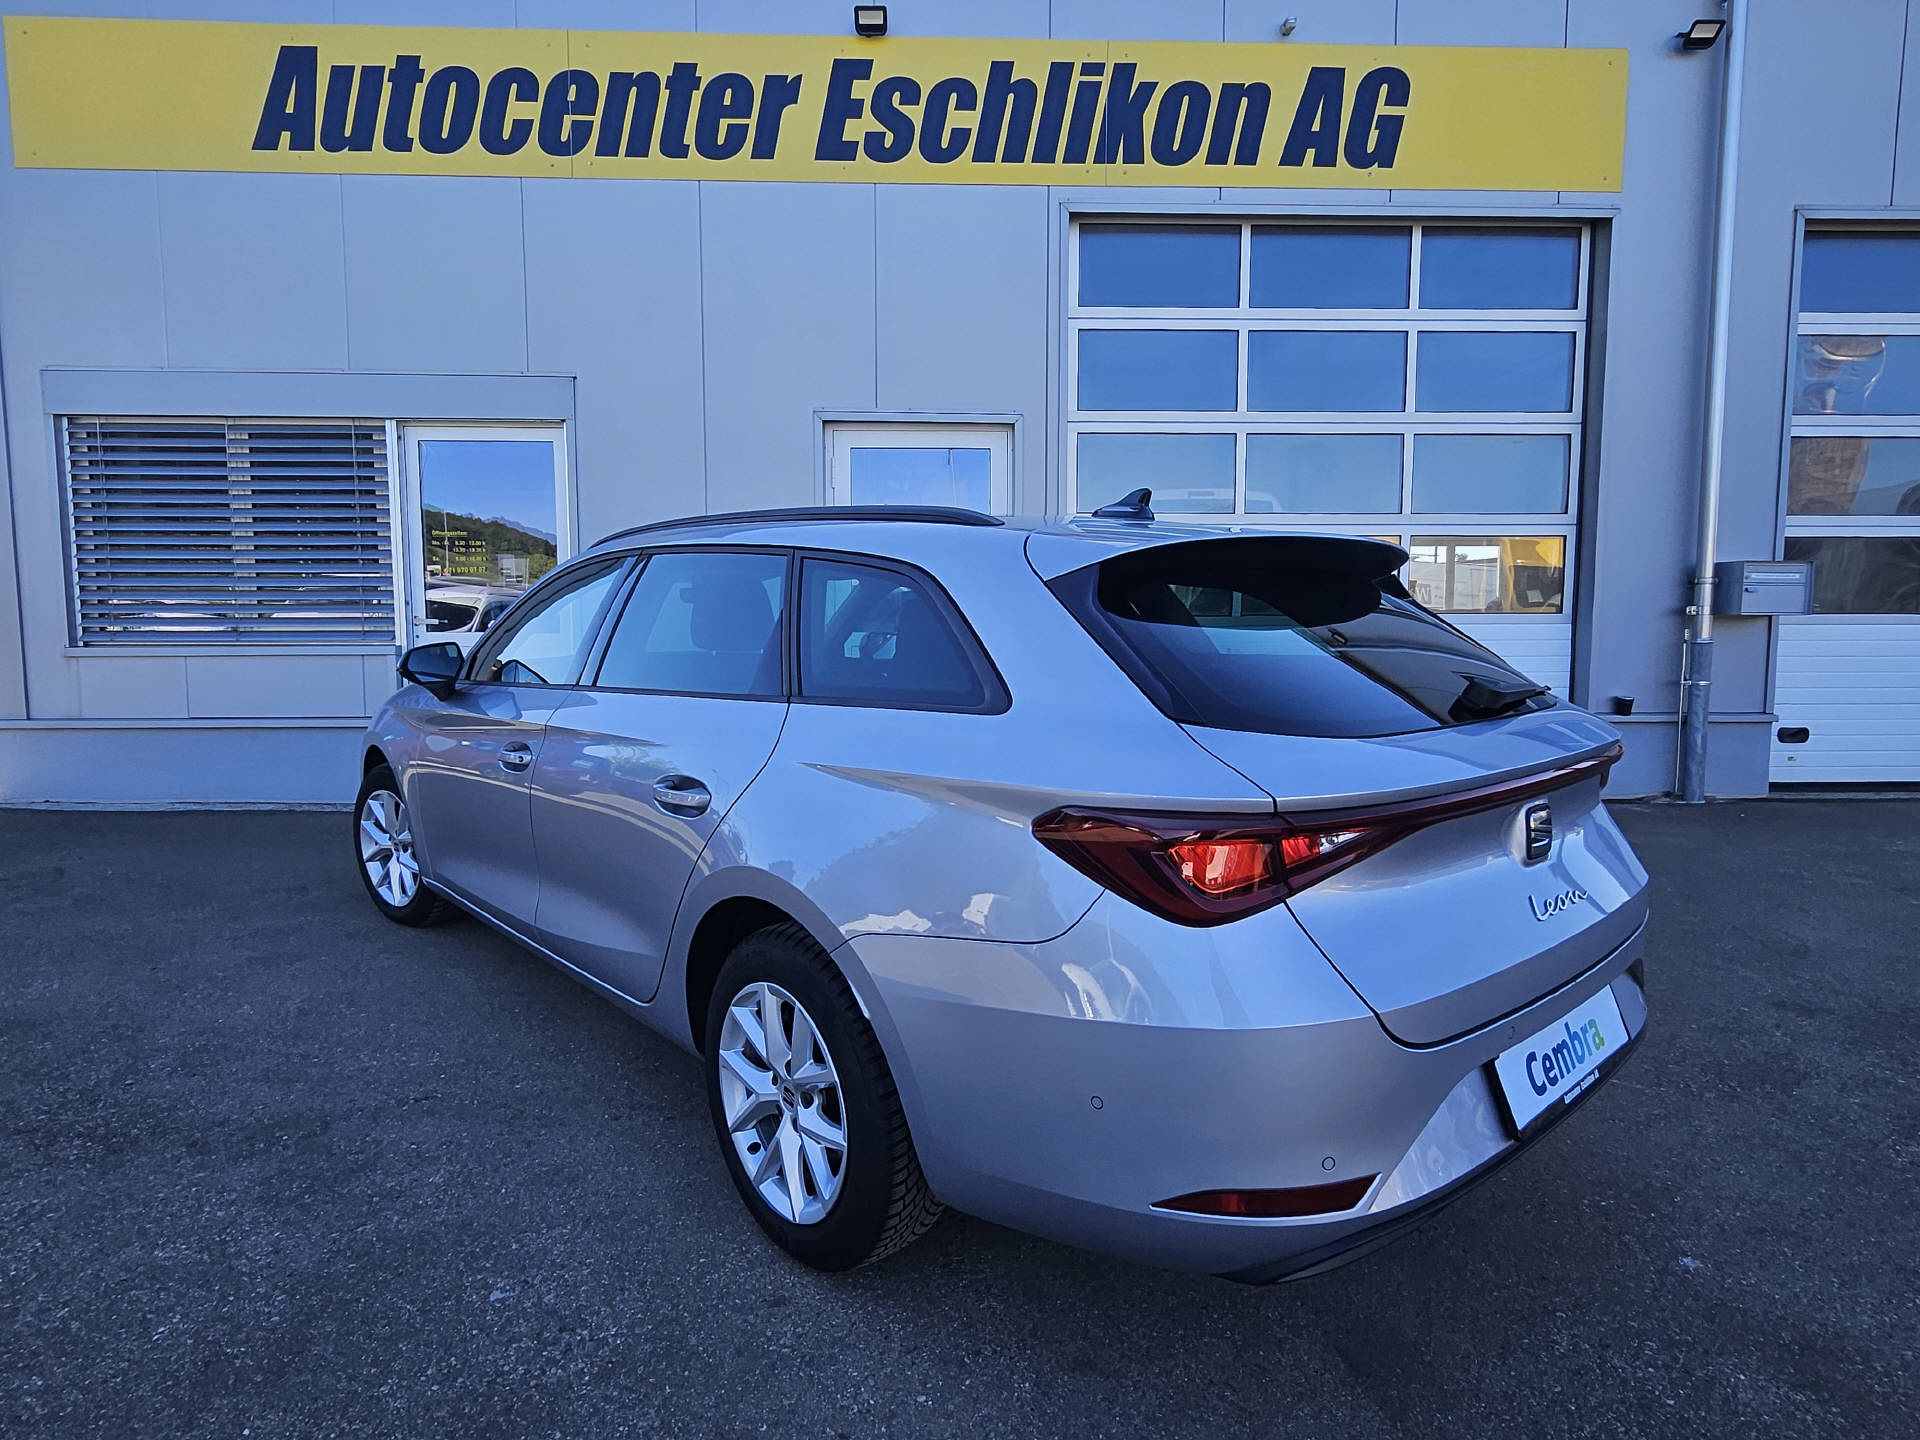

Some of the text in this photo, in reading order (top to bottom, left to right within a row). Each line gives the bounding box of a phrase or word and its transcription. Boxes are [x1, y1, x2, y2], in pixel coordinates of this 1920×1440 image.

[252, 45, 1411, 169] Autocenter Eschlikon AG
[1528, 890, 1588, 922] Leon
[1525, 1018, 1605, 1097] Cembra
